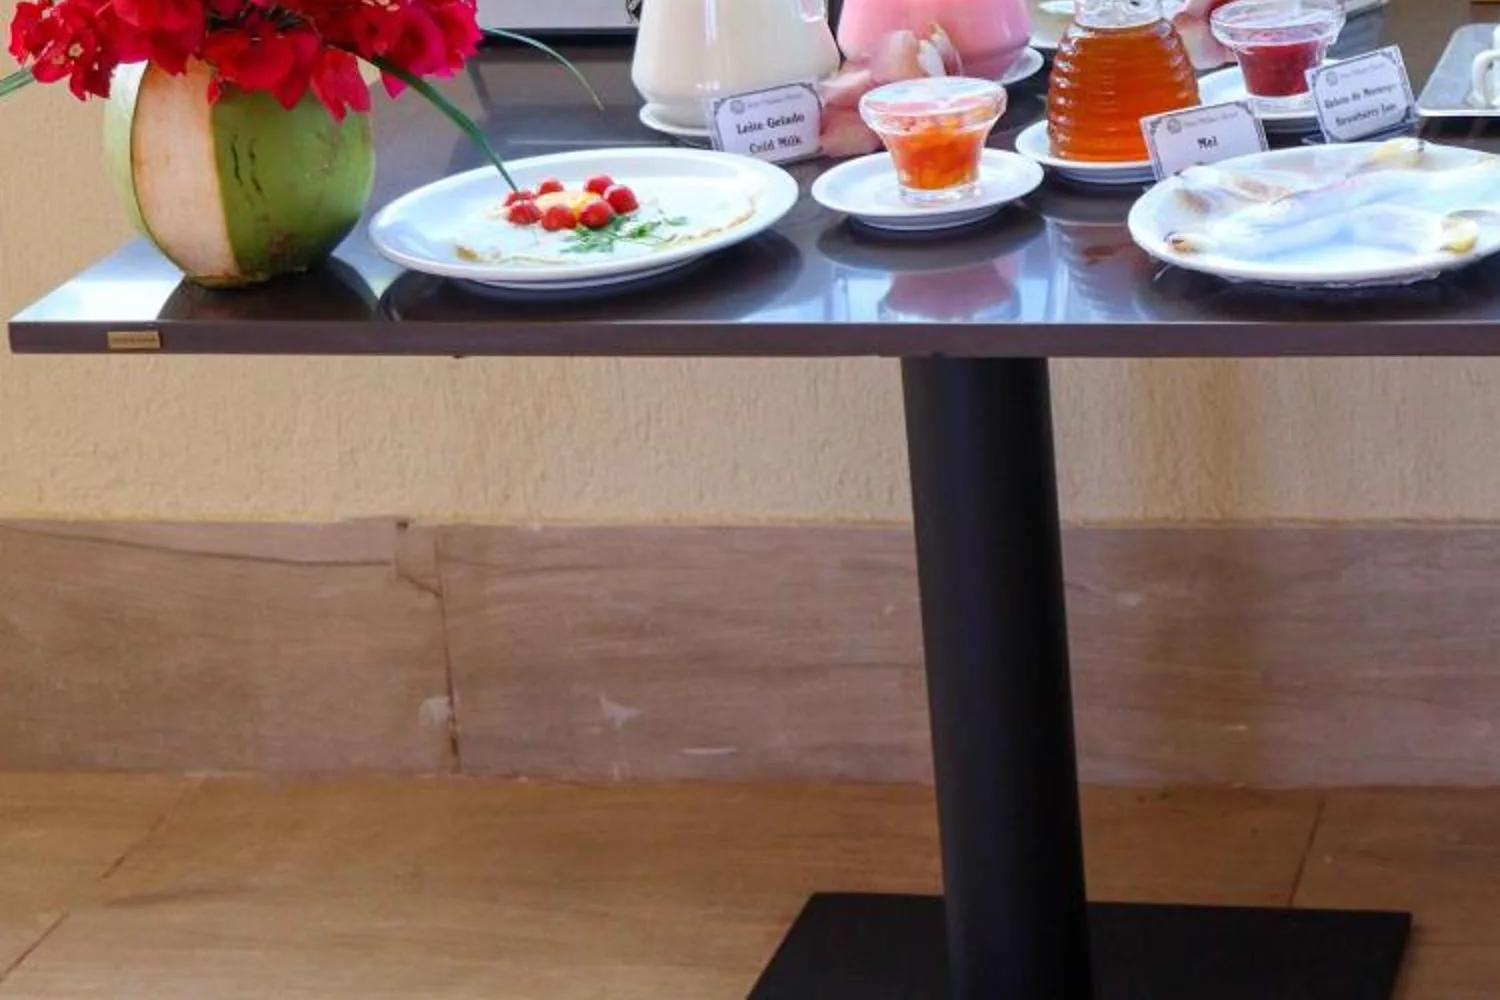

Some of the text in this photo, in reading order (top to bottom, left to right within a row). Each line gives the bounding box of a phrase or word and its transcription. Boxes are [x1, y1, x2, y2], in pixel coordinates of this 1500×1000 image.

[736, 112, 805, 135] Leite Gelado
[749, 134, 803, 154] Cold Milk
[1197, 135, 1219, 150] Mel
